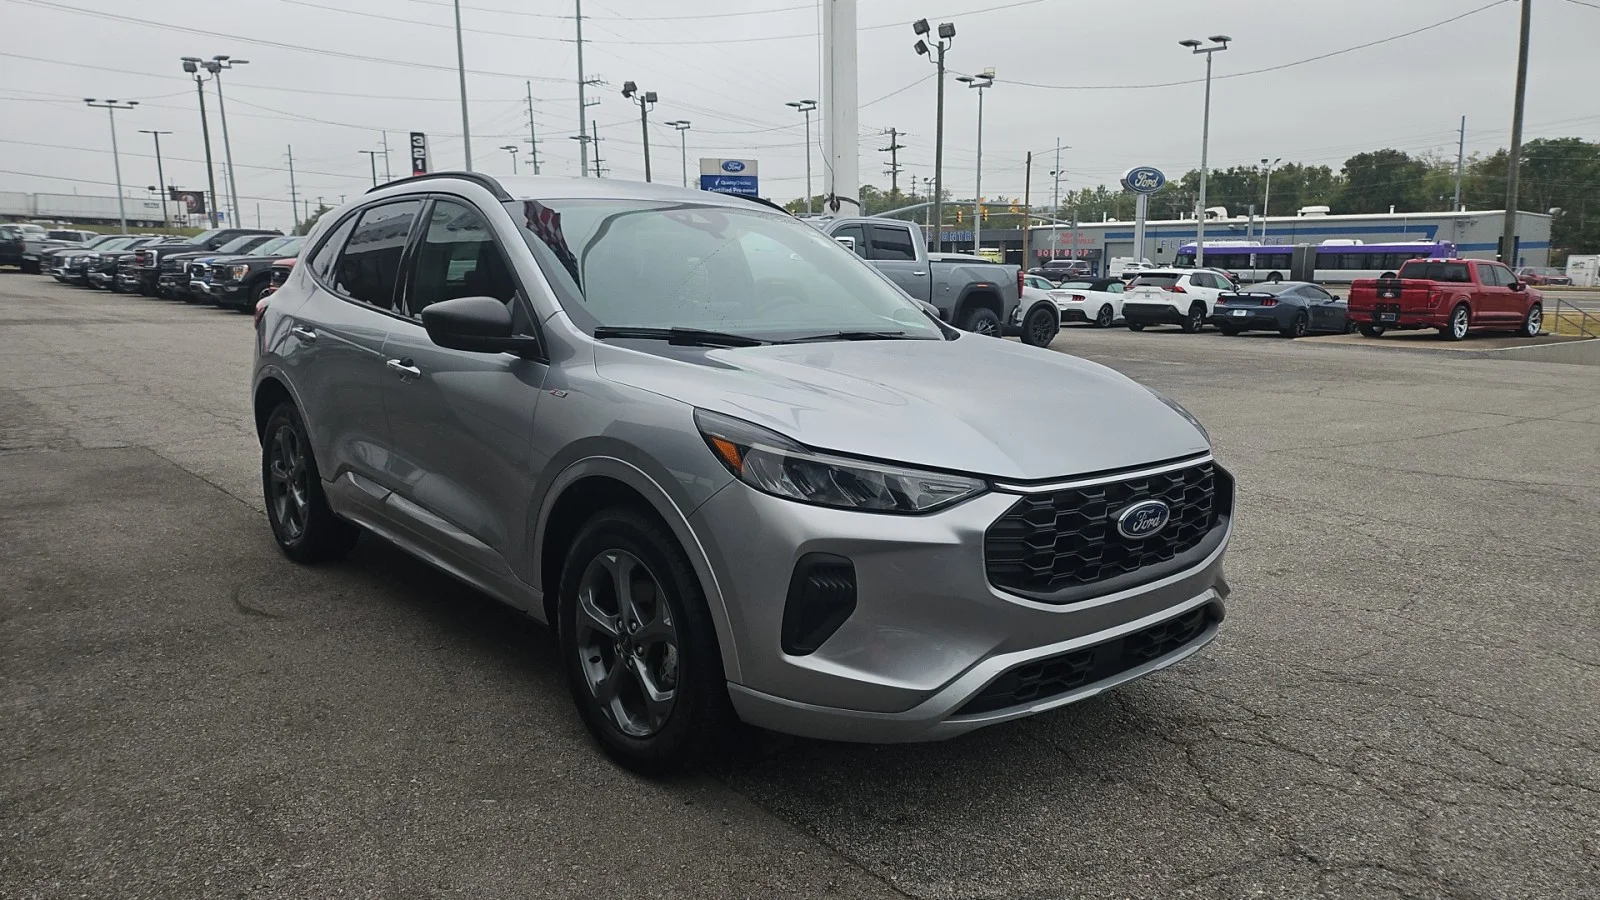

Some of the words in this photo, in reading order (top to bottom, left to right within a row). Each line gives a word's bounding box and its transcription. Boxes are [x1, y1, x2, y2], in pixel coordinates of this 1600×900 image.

[728, 162, 741, 170] Ford
[1134, 170, 1159, 188] Ford
[1133, 509, 1161, 531] Ford
